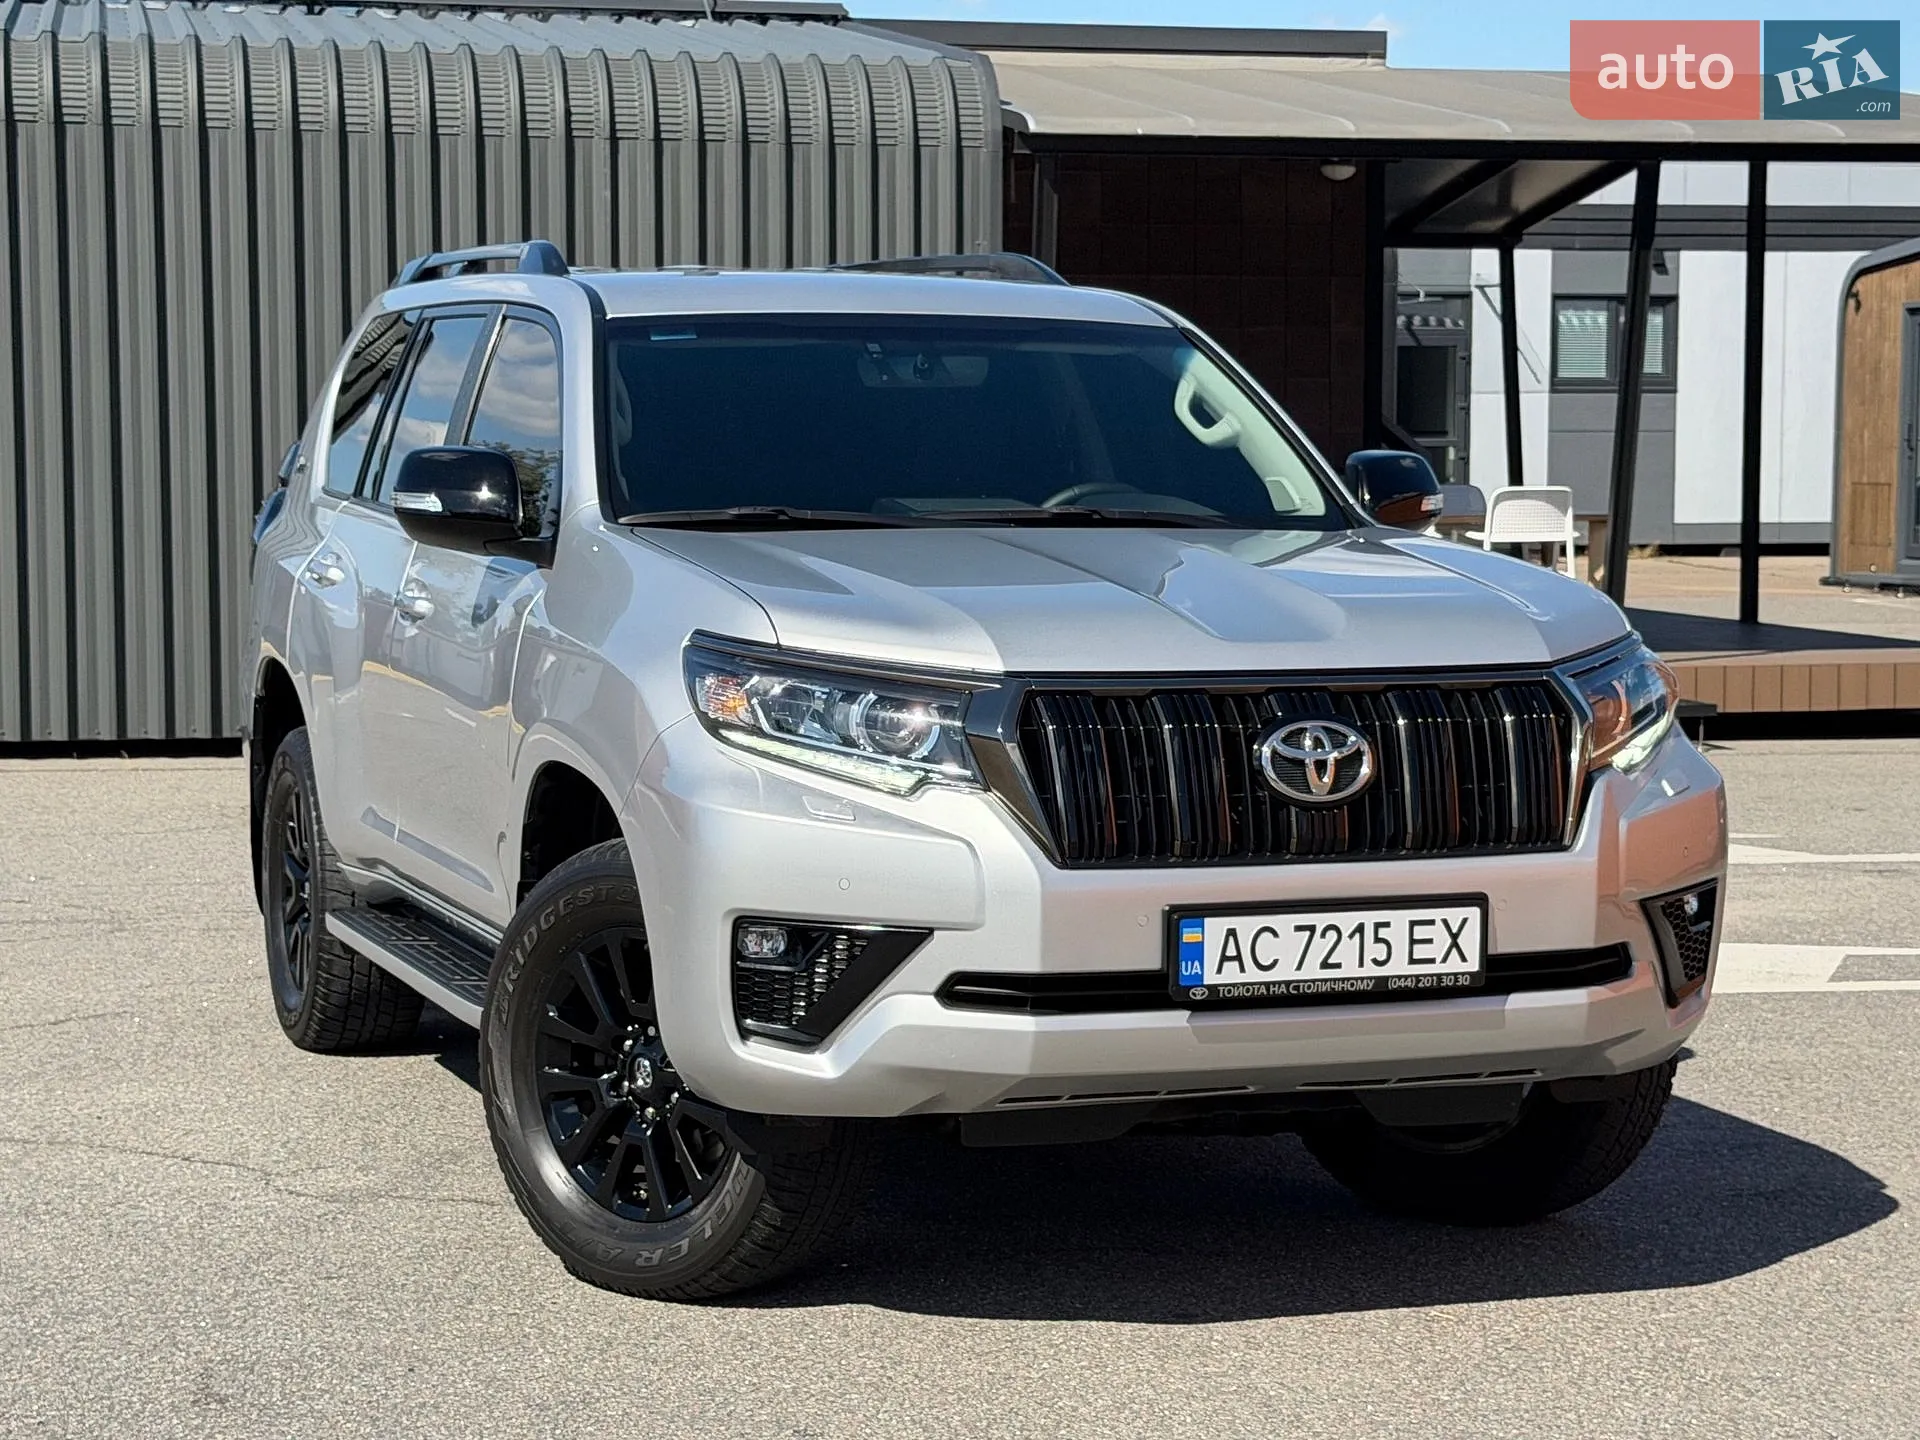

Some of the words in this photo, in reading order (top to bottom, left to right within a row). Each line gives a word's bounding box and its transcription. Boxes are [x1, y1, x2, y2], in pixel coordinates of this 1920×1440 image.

[1215, 925, 1280, 975] AC
[1293, 921, 1393, 972] 7215
[1407, 916, 1470, 966] EX
[500, 883, 638, 1030] BRIDGESTO
[1181, 960, 1202, 976] UA
[1217, 984, 1267, 998] ТОЙОТА
[1269, 983, 1287, 996] НА
[1289, 979, 1375, 995] СТОЛИЧНОМУ
[1388, 976, 1416, 990] (044)
[1418, 976, 1437, 988] 201
[1440, 975, 1454, 987] 30
[1456, 974, 1470, 986] 30
